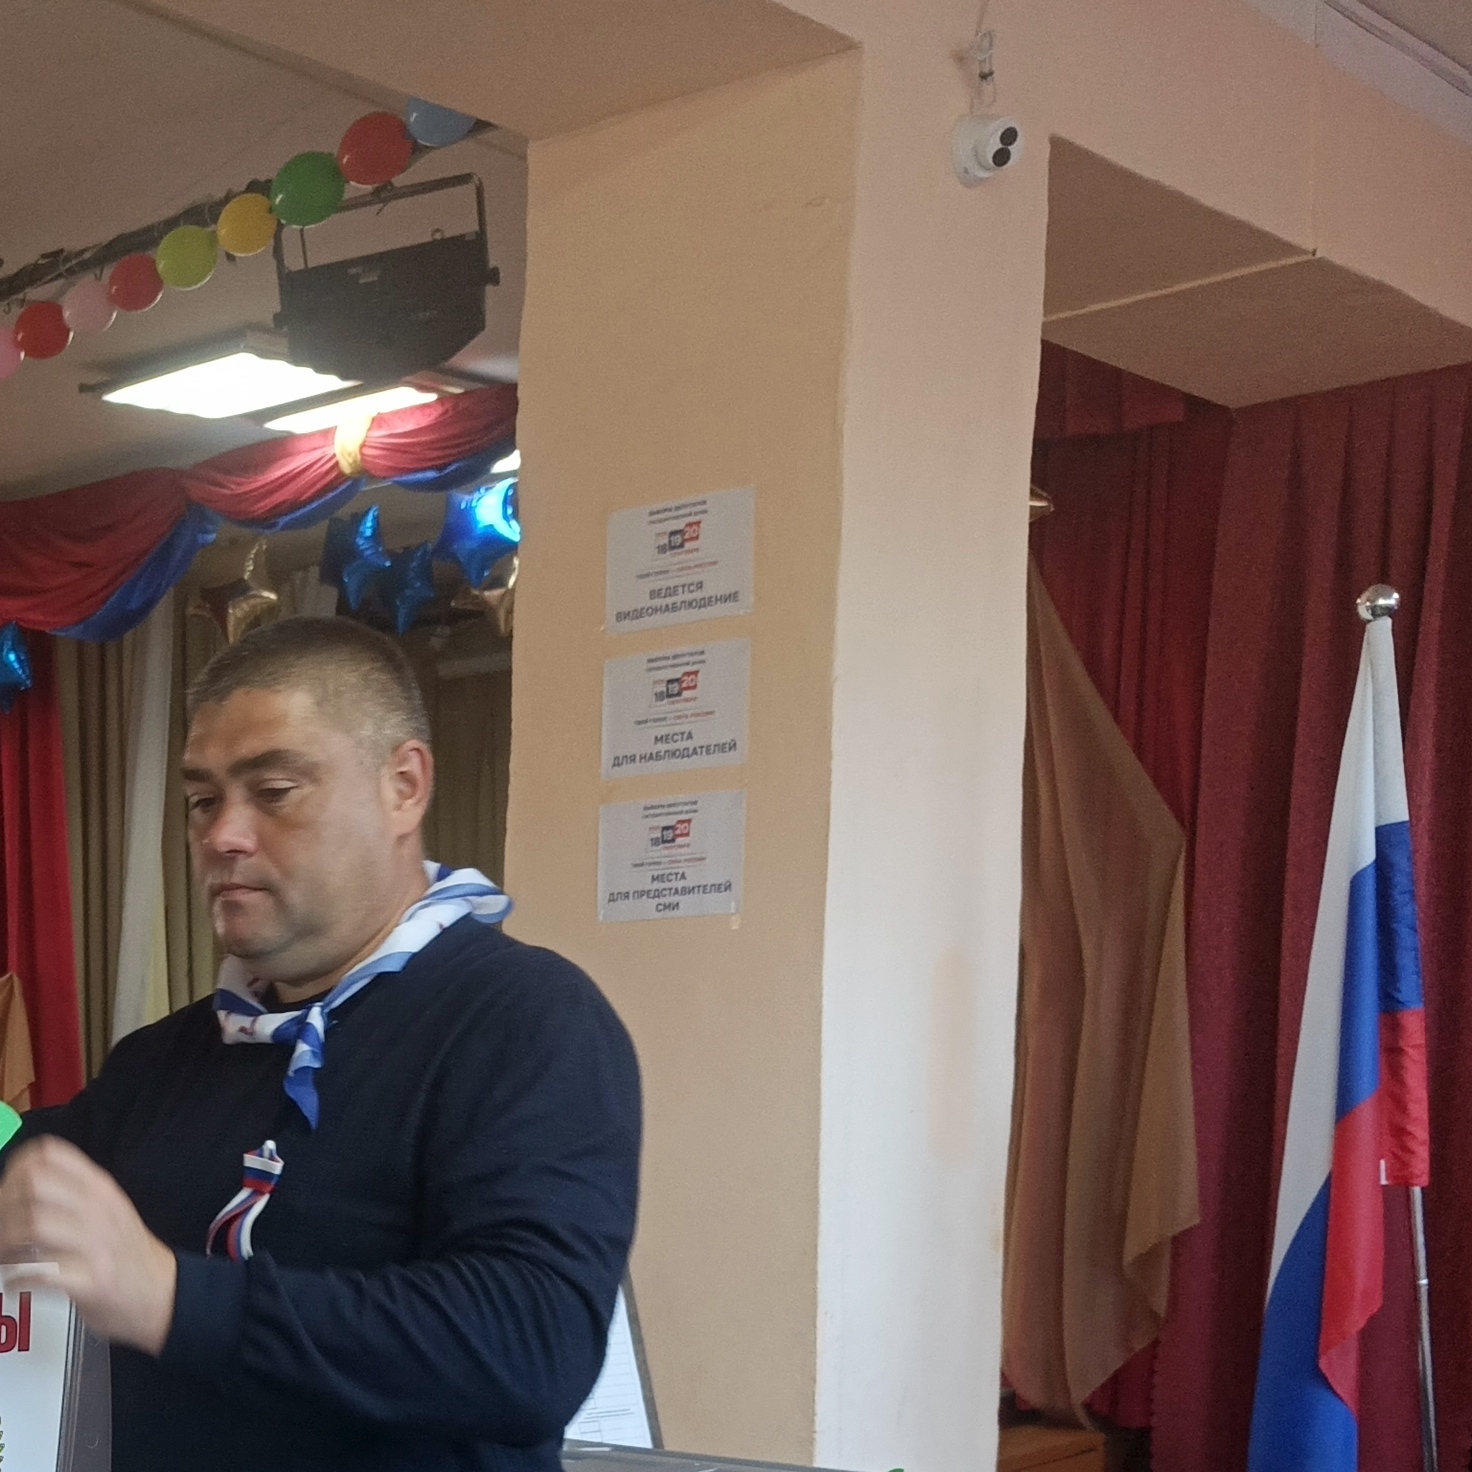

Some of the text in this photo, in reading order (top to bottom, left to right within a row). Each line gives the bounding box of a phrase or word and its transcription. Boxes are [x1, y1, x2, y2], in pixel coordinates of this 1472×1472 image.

[683, 526, 699, 540] 20
[649, 581, 703, 600] ВЕДЕТСЯ
[615, 591, 739, 623] ВИДЕОНАБЛЮДЕНИЕ
[681, 675, 696, 688] 20
[654, 730, 693, 745] МЕСТА
[611, 738, 737, 768] ДЛЯ НАБЛЮДАТЕЛЕЙ
[651, 871, 687, 884] МЕСТА
[608, 879, 732, 903] ДЛЯ ПРЕДСТАВИТЕЛЕЙ
[655, 902, 679, 913] СМИ
